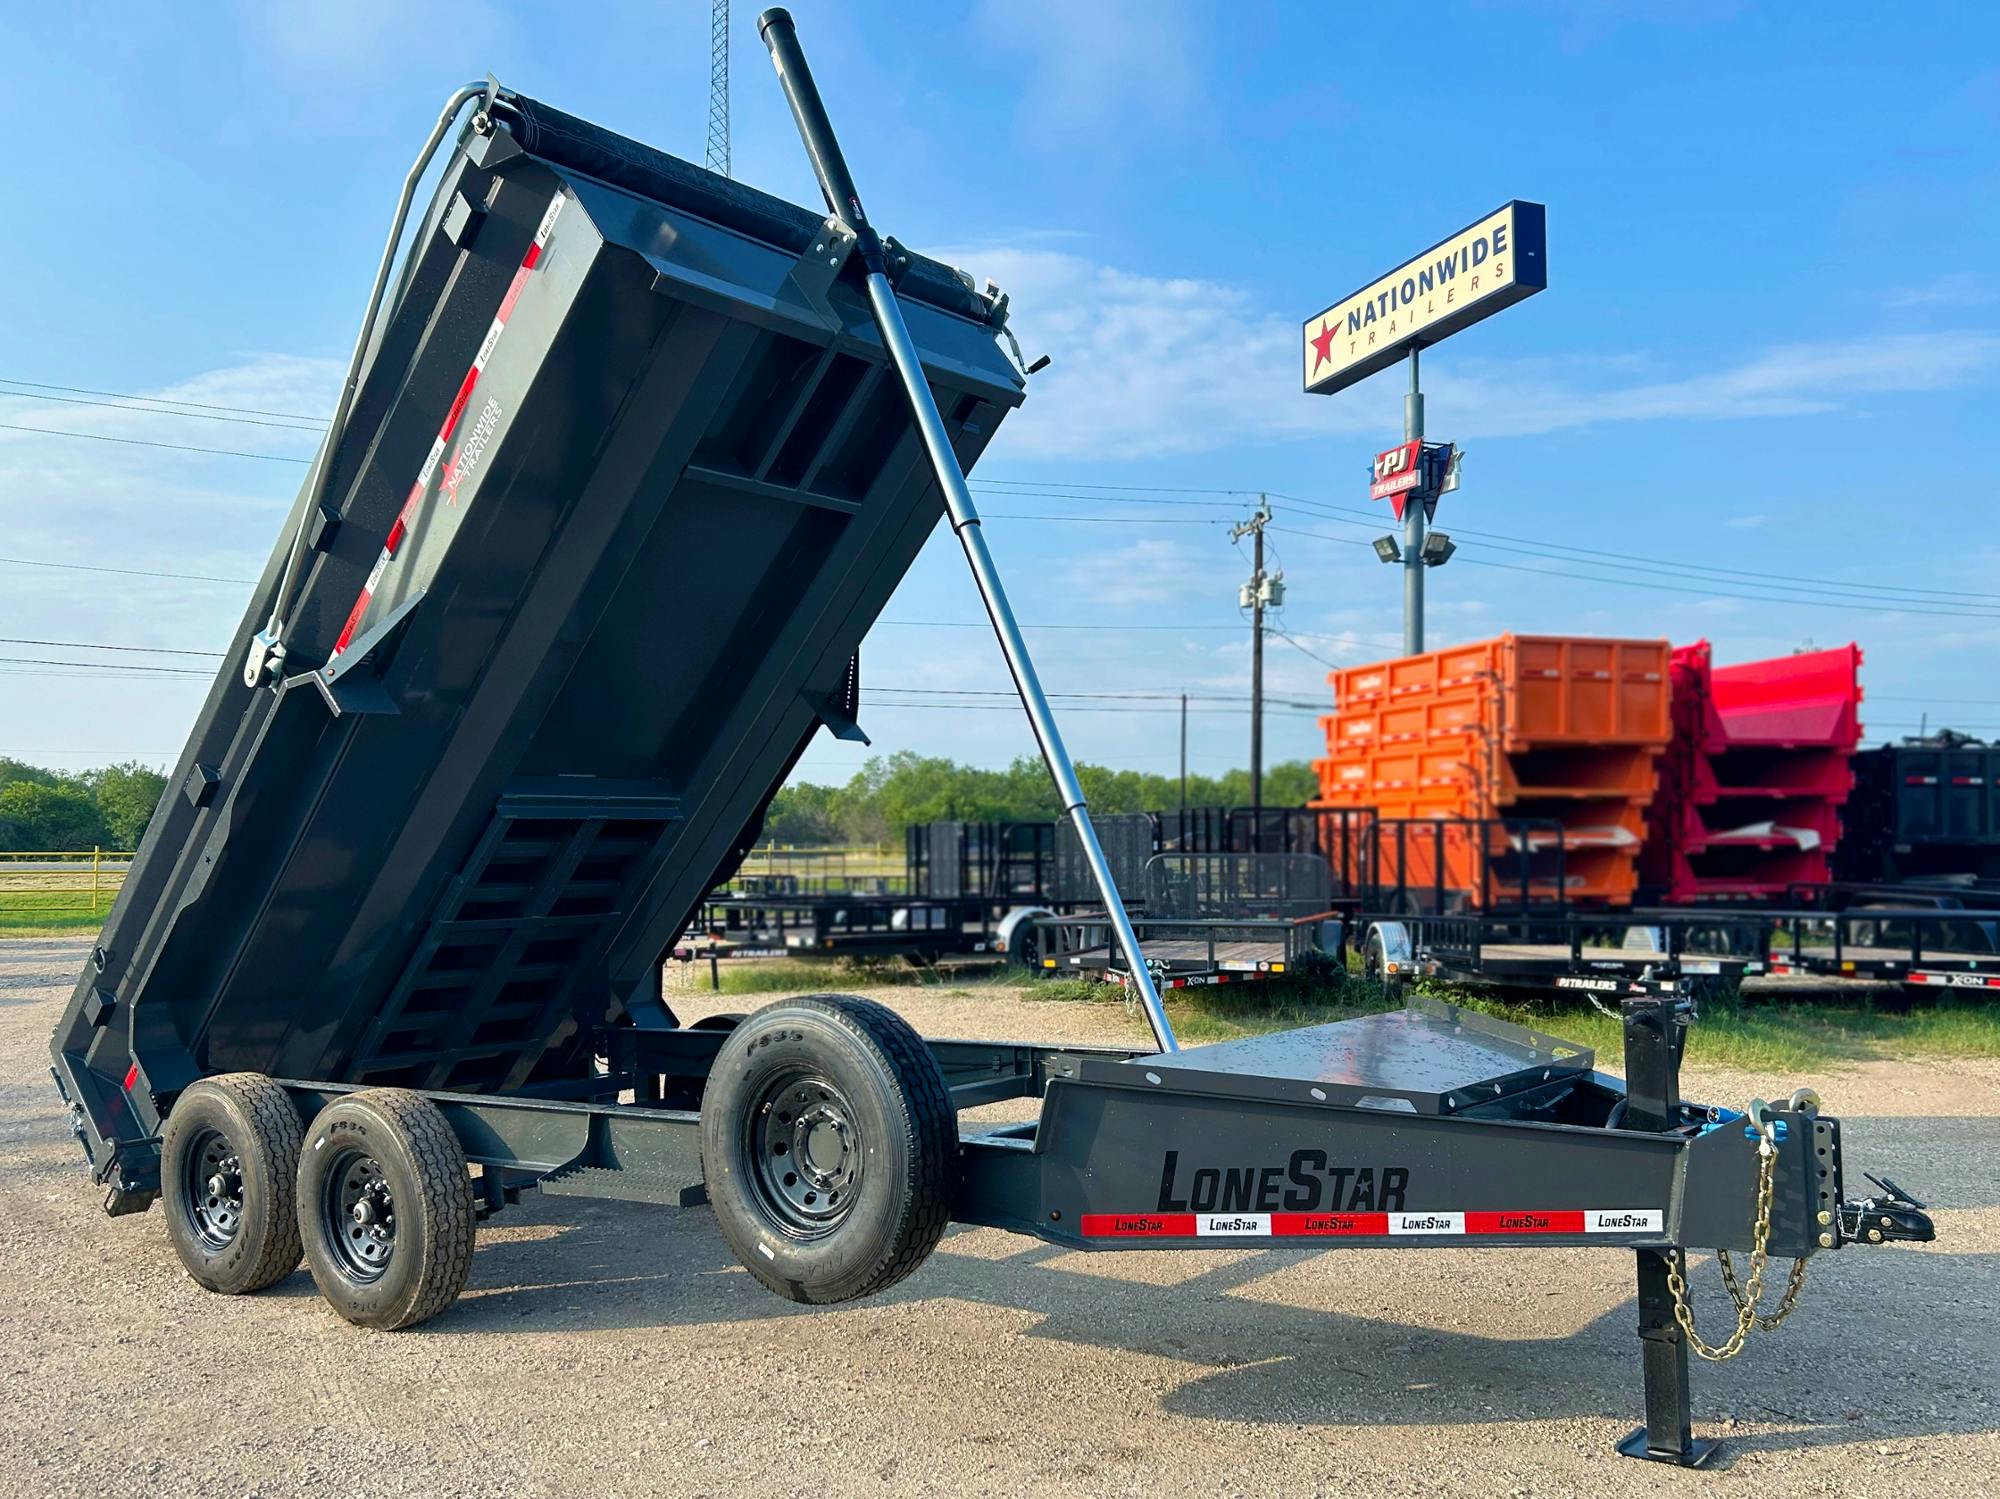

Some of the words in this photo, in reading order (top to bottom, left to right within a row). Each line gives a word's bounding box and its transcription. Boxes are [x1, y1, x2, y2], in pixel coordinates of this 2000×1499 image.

[1348, 223, 1508, 336] NATIONWIDE
[1350, 262, 1505, 355] TRAILERS
[447, 395, 498, 489] NATIONWIDE
[463, 406, 503, 477] TRAILERS
[1382, 447, 1409, 477] PJ
[1373, 474, 1415, 497] TRAILERS
[1952, 974, 1984, 985] X-ON
